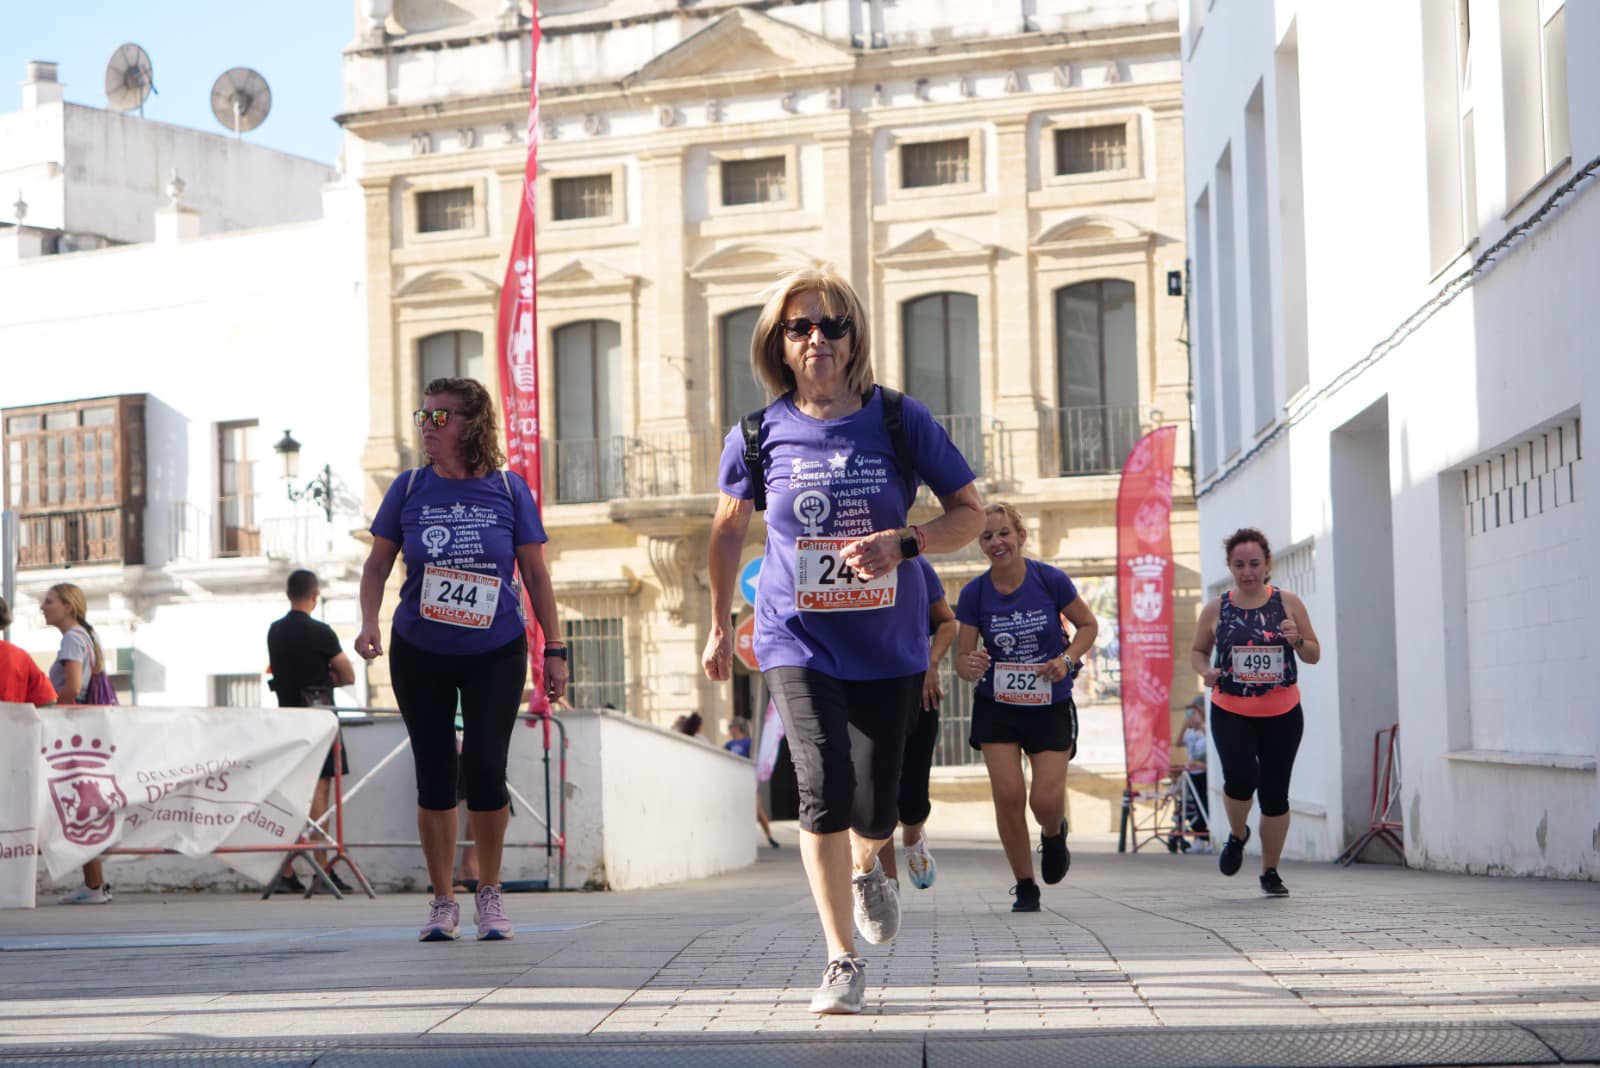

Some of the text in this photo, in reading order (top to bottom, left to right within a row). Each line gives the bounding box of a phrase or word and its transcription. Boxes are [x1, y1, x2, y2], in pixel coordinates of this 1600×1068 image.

[790, 468, 886, 482] CARRERA DE LA MUJER
[789, 480, 821, 490] CHICLANA
[832, 485, 881, 498] VALIENTES
[838, 498, 868, 507] LIBRES
[836, 507, 870, 518] SABIAS
[833, 519, 872, 527] FUERTES
[829, 526, 873, 537] VALIOSAS
[801, 540, 838, 551] Carrera
[448, 549, 484, 557] VALIOSAS
[437, 580, 478, 608] 244
[800, 587, 891, 609] CHICLANA
[423, 604, 488, 627] CHICLANA
[1243, 654, 1271, 670] 499
[1006, 672, 1037, 690] 252
